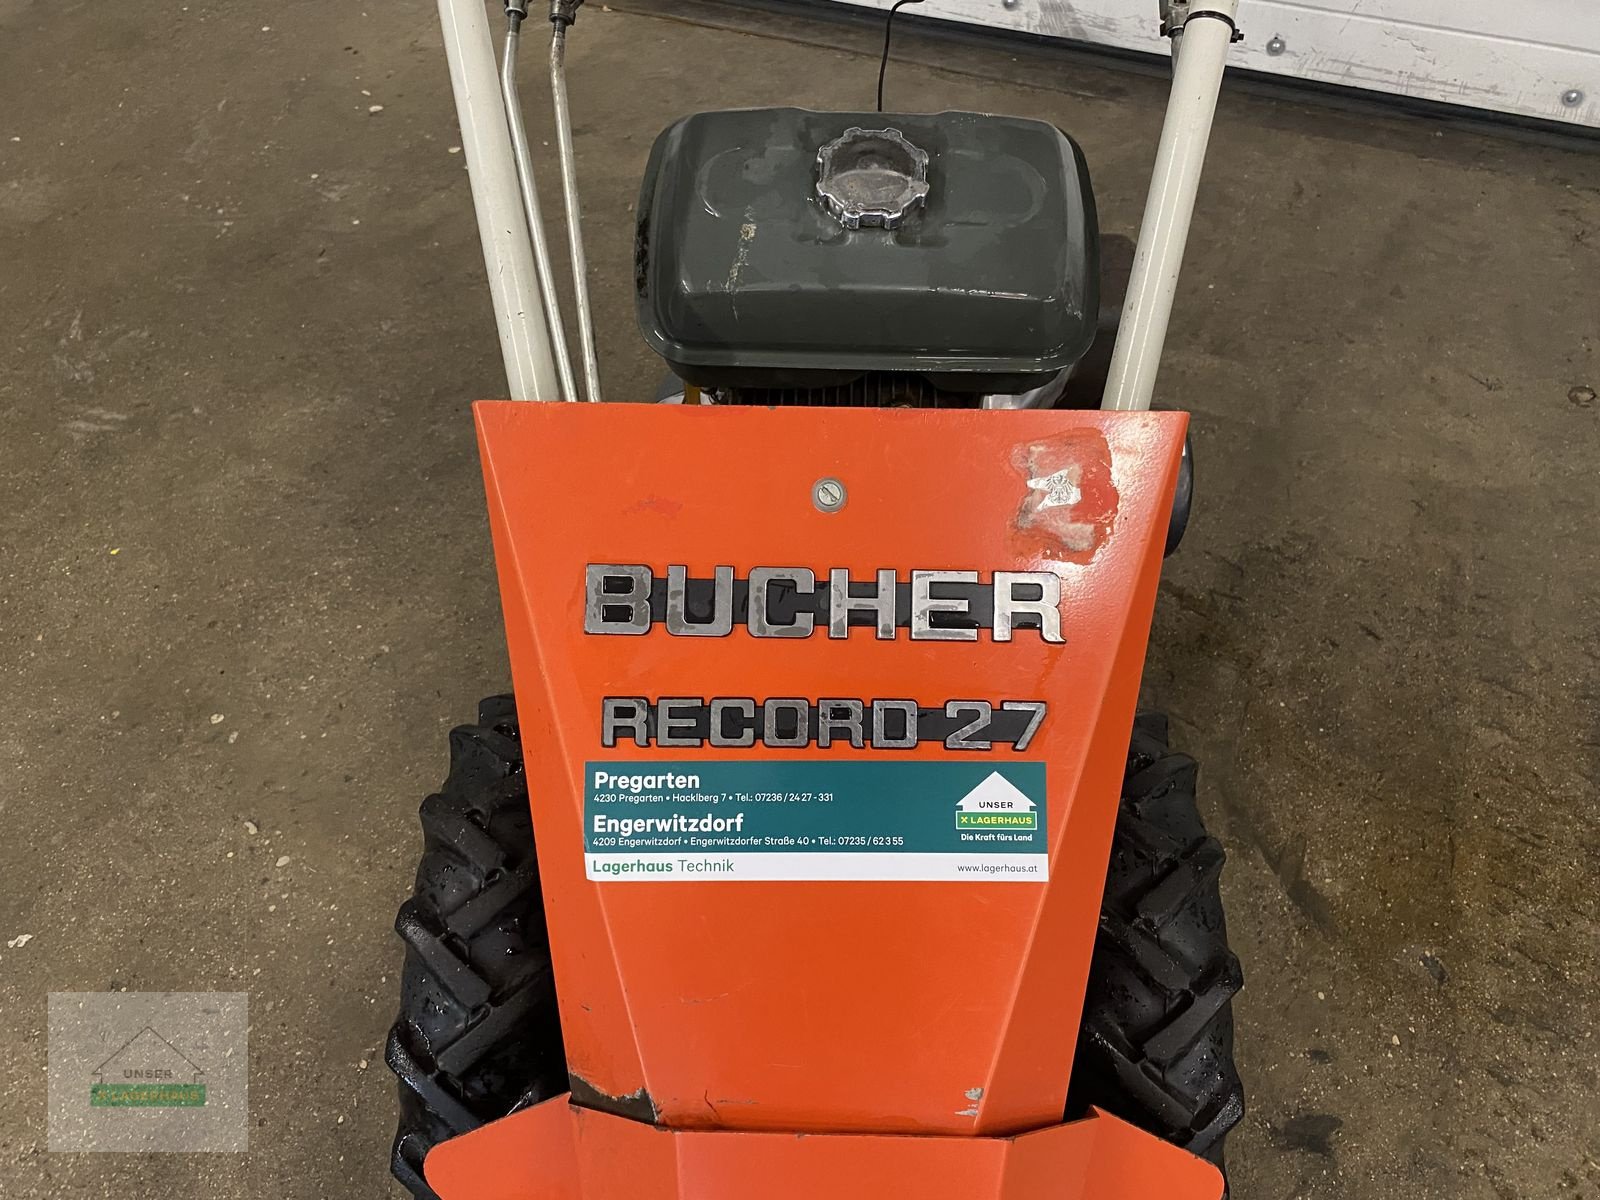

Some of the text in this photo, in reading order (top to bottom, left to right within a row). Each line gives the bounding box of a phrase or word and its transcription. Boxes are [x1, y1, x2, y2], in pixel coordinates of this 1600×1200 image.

[584, 563, 1066, 643] BUCHER
[601, 696, 1048, 752] RECORD 27
[594, 771, 700, 793] Pregarten
[593, 794, 617, 802] 4230
[618, 794, 664, 803] Pregarten
[672, 793, 719, 803] Hacklberg
[720, 793, 726, 802] 7
[735, 793, 753, 802] Tel.:
[978, 801, 1014, 809] UNSER
[593, 813, 744, 836] Engerwitzdorf
[970, 816, 1032, 824] LAGERHAUS
[592, 837, 616, 846] 4209
[618, 836, 682, 847] Engerwitzdorf
[690, 837, 762, 847] Engerwitzdorfer
[764, 836, 795, 846] Straße
[797, 836, 809, 846] 40
[818, 836, 836, 846] Tel.:
[960, 833, 1033, 841] Die Kraft fürs Land
[593, 859, 735, 875] Lagerhaus Technik
[957, 864, 1038, 874] www.lagerhaus.at
